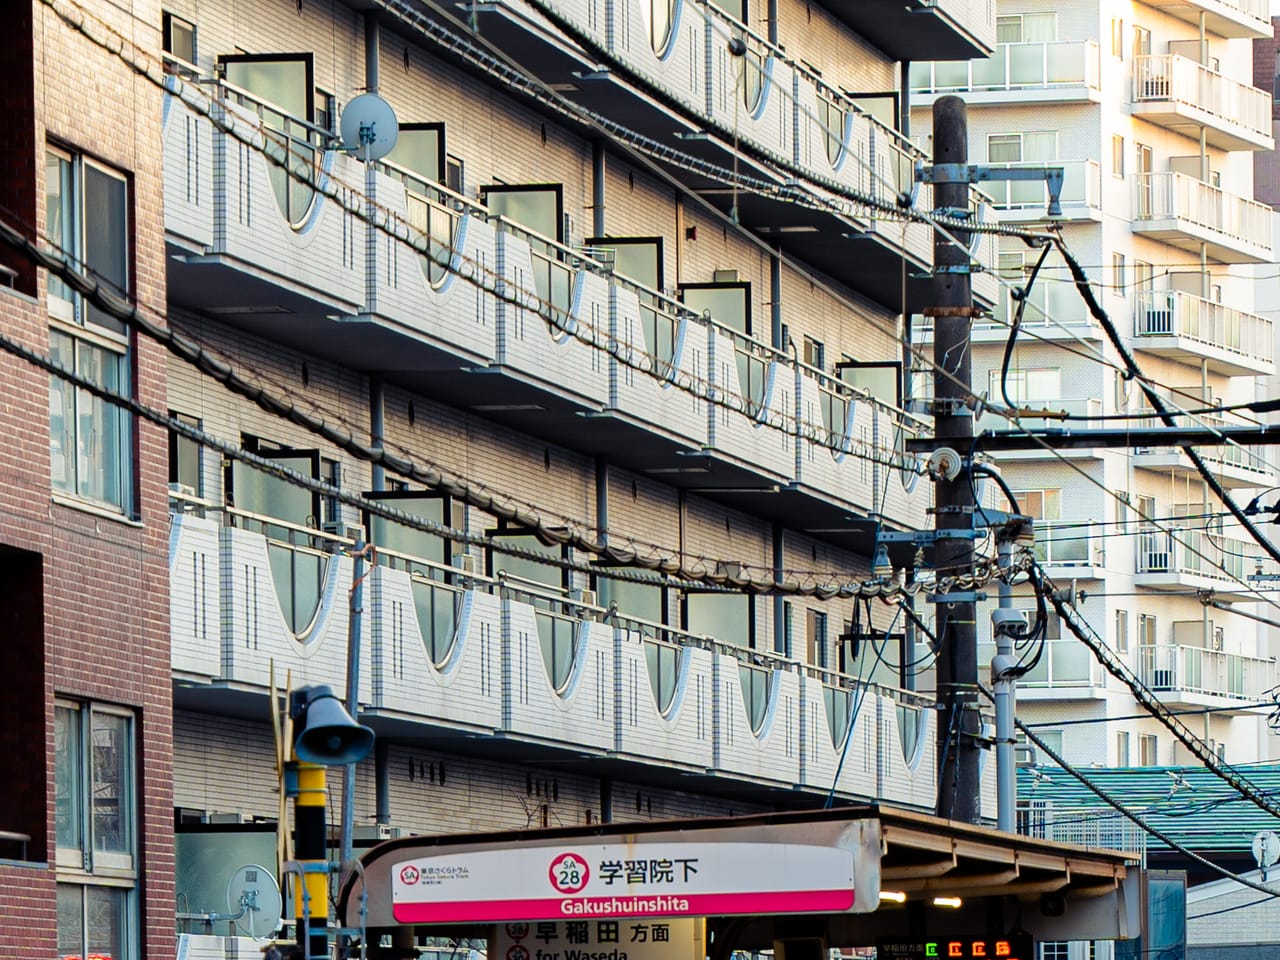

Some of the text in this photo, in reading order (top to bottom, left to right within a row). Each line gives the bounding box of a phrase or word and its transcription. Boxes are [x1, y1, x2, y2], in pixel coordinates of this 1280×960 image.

[563, 860, 577, 869] SA
[599, 858, 699, 885] 学習院下
[404, 871, 416, 880] SA
[559, 870, 580, 885] 28
[560, 896, 689, 915] Gakushuinshita
[630, 923, 670, 943] 方面
